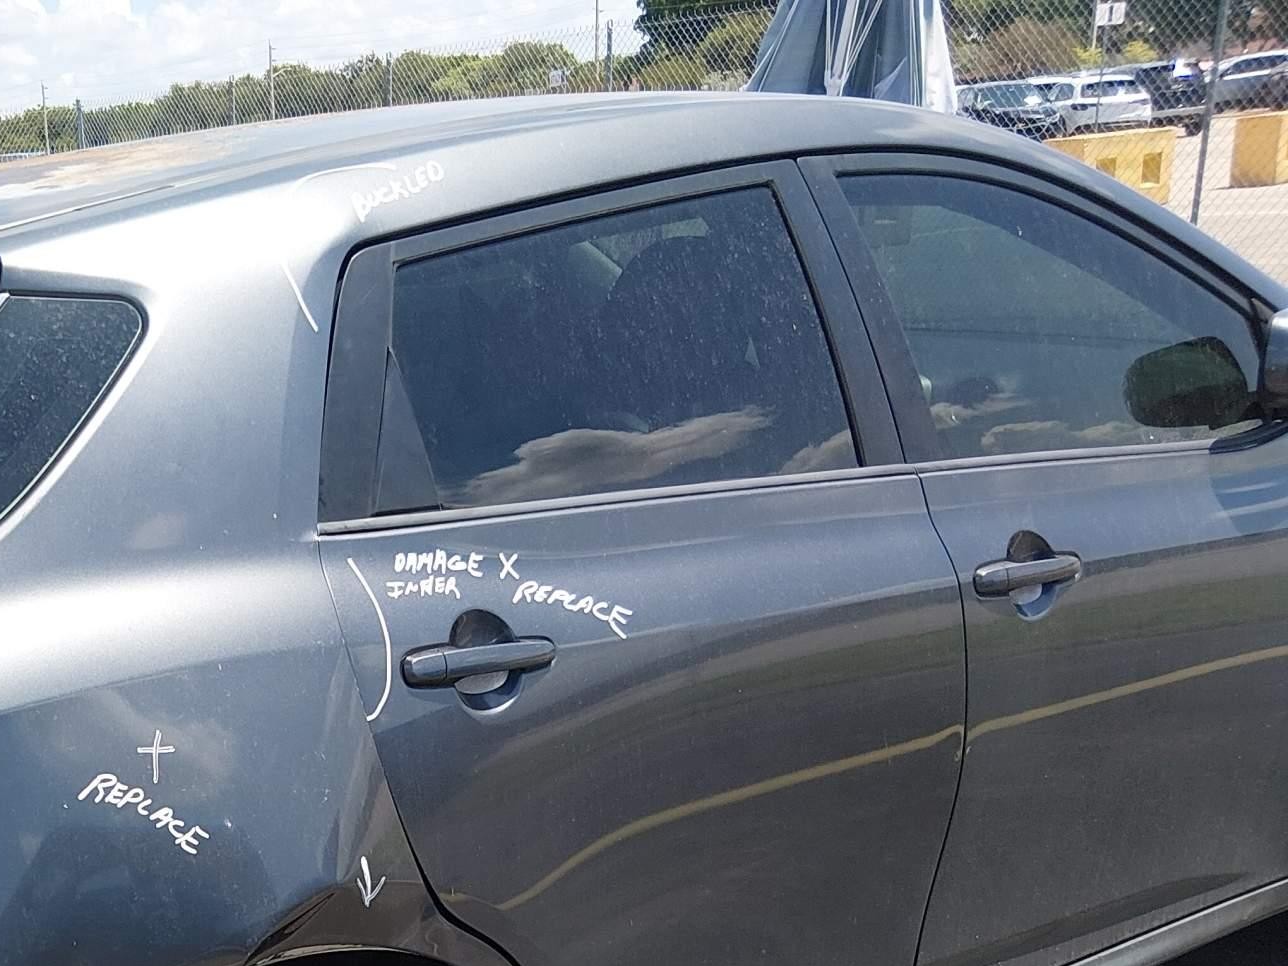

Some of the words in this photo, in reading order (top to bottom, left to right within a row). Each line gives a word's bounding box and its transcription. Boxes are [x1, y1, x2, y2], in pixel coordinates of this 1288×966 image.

[351, 160, 444, 223] BUCKLED
[394, 548, 483, 577] DAMAGE
[386, 575, 460, 599] INNER
[512, 580, 633, 639] REPLACE
[77, 773, 209, 855] REPLACE
